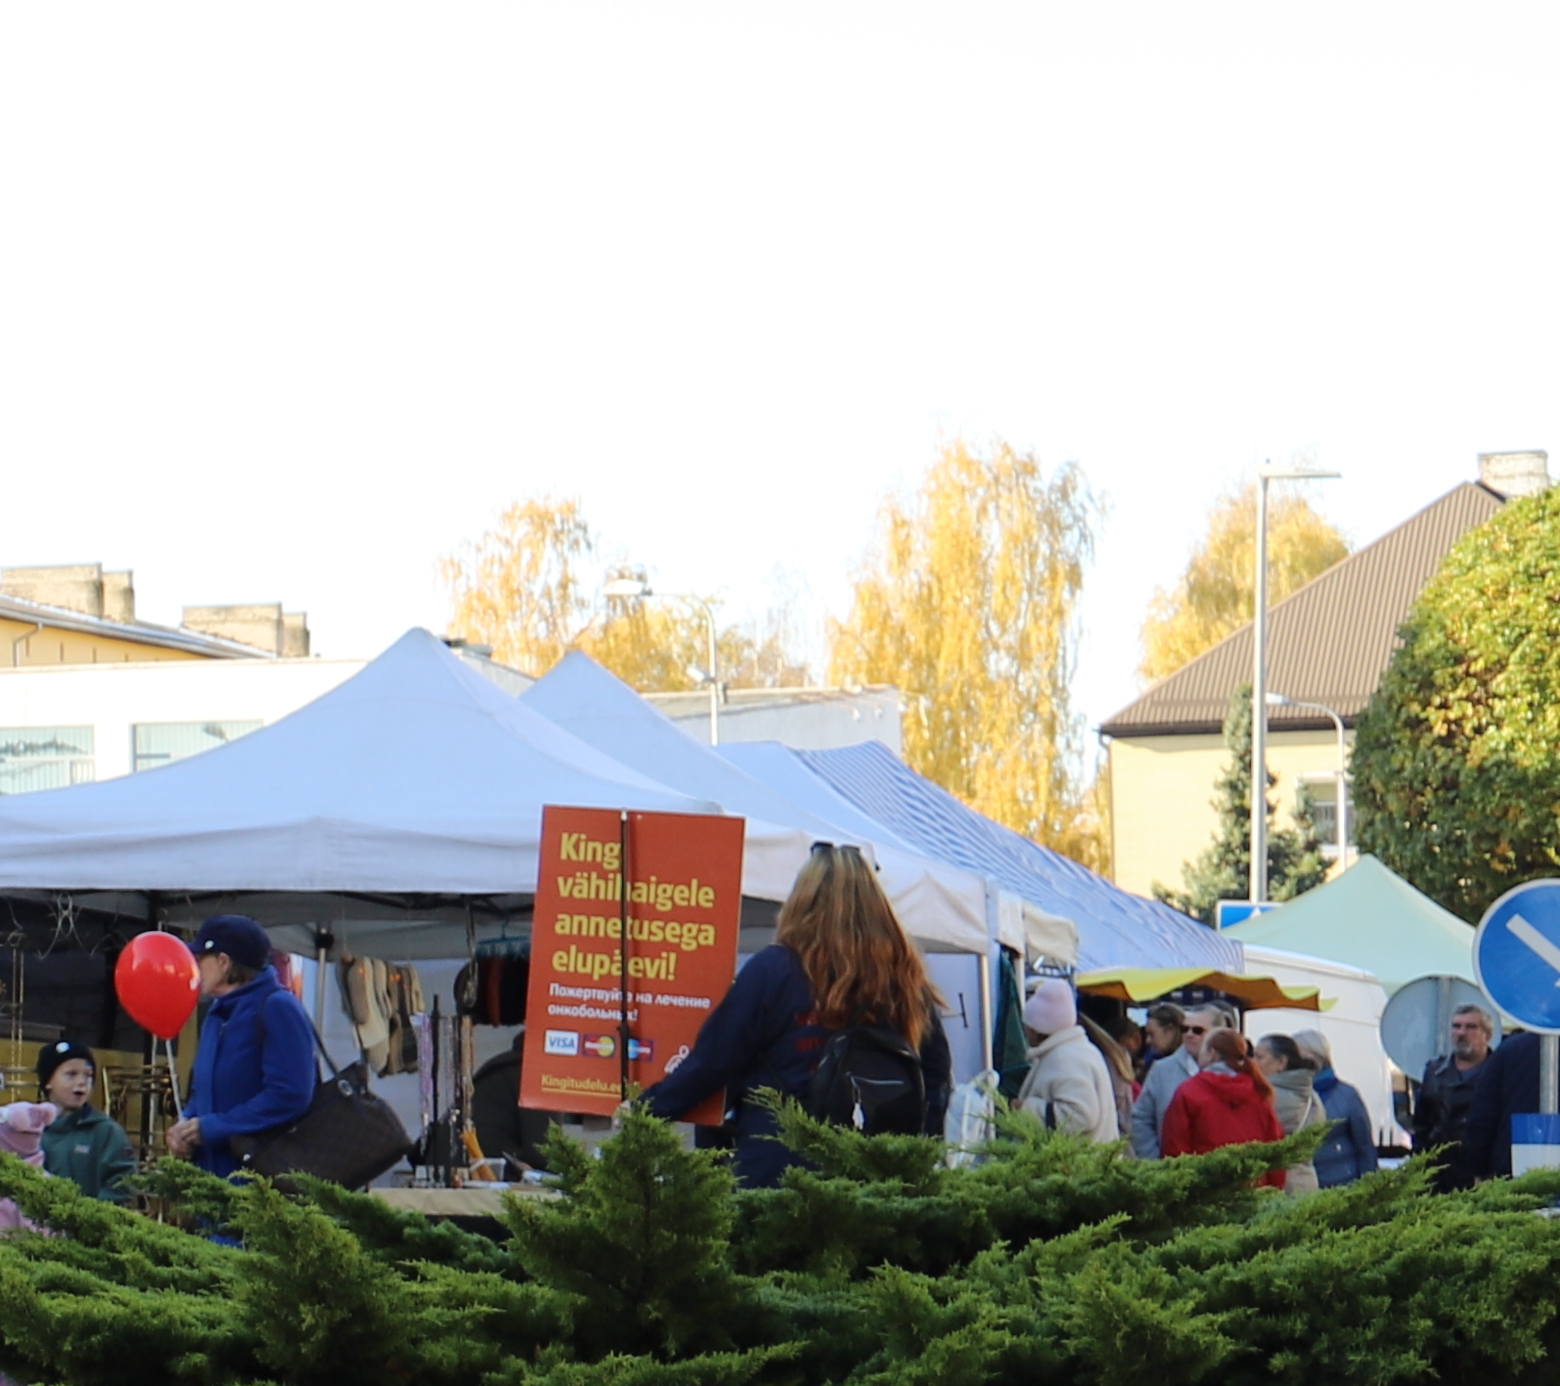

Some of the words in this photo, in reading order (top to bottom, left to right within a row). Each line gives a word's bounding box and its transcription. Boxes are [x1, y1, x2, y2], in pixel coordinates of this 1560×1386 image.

[560, 832, 622, 870] King
[557, 871, 715, 911] vähihaigele
[554, 913, 716, 951] annetusega
[552, 944, 677, 981] elupäevi!
[549, 1035, 575, 1049] VISA
